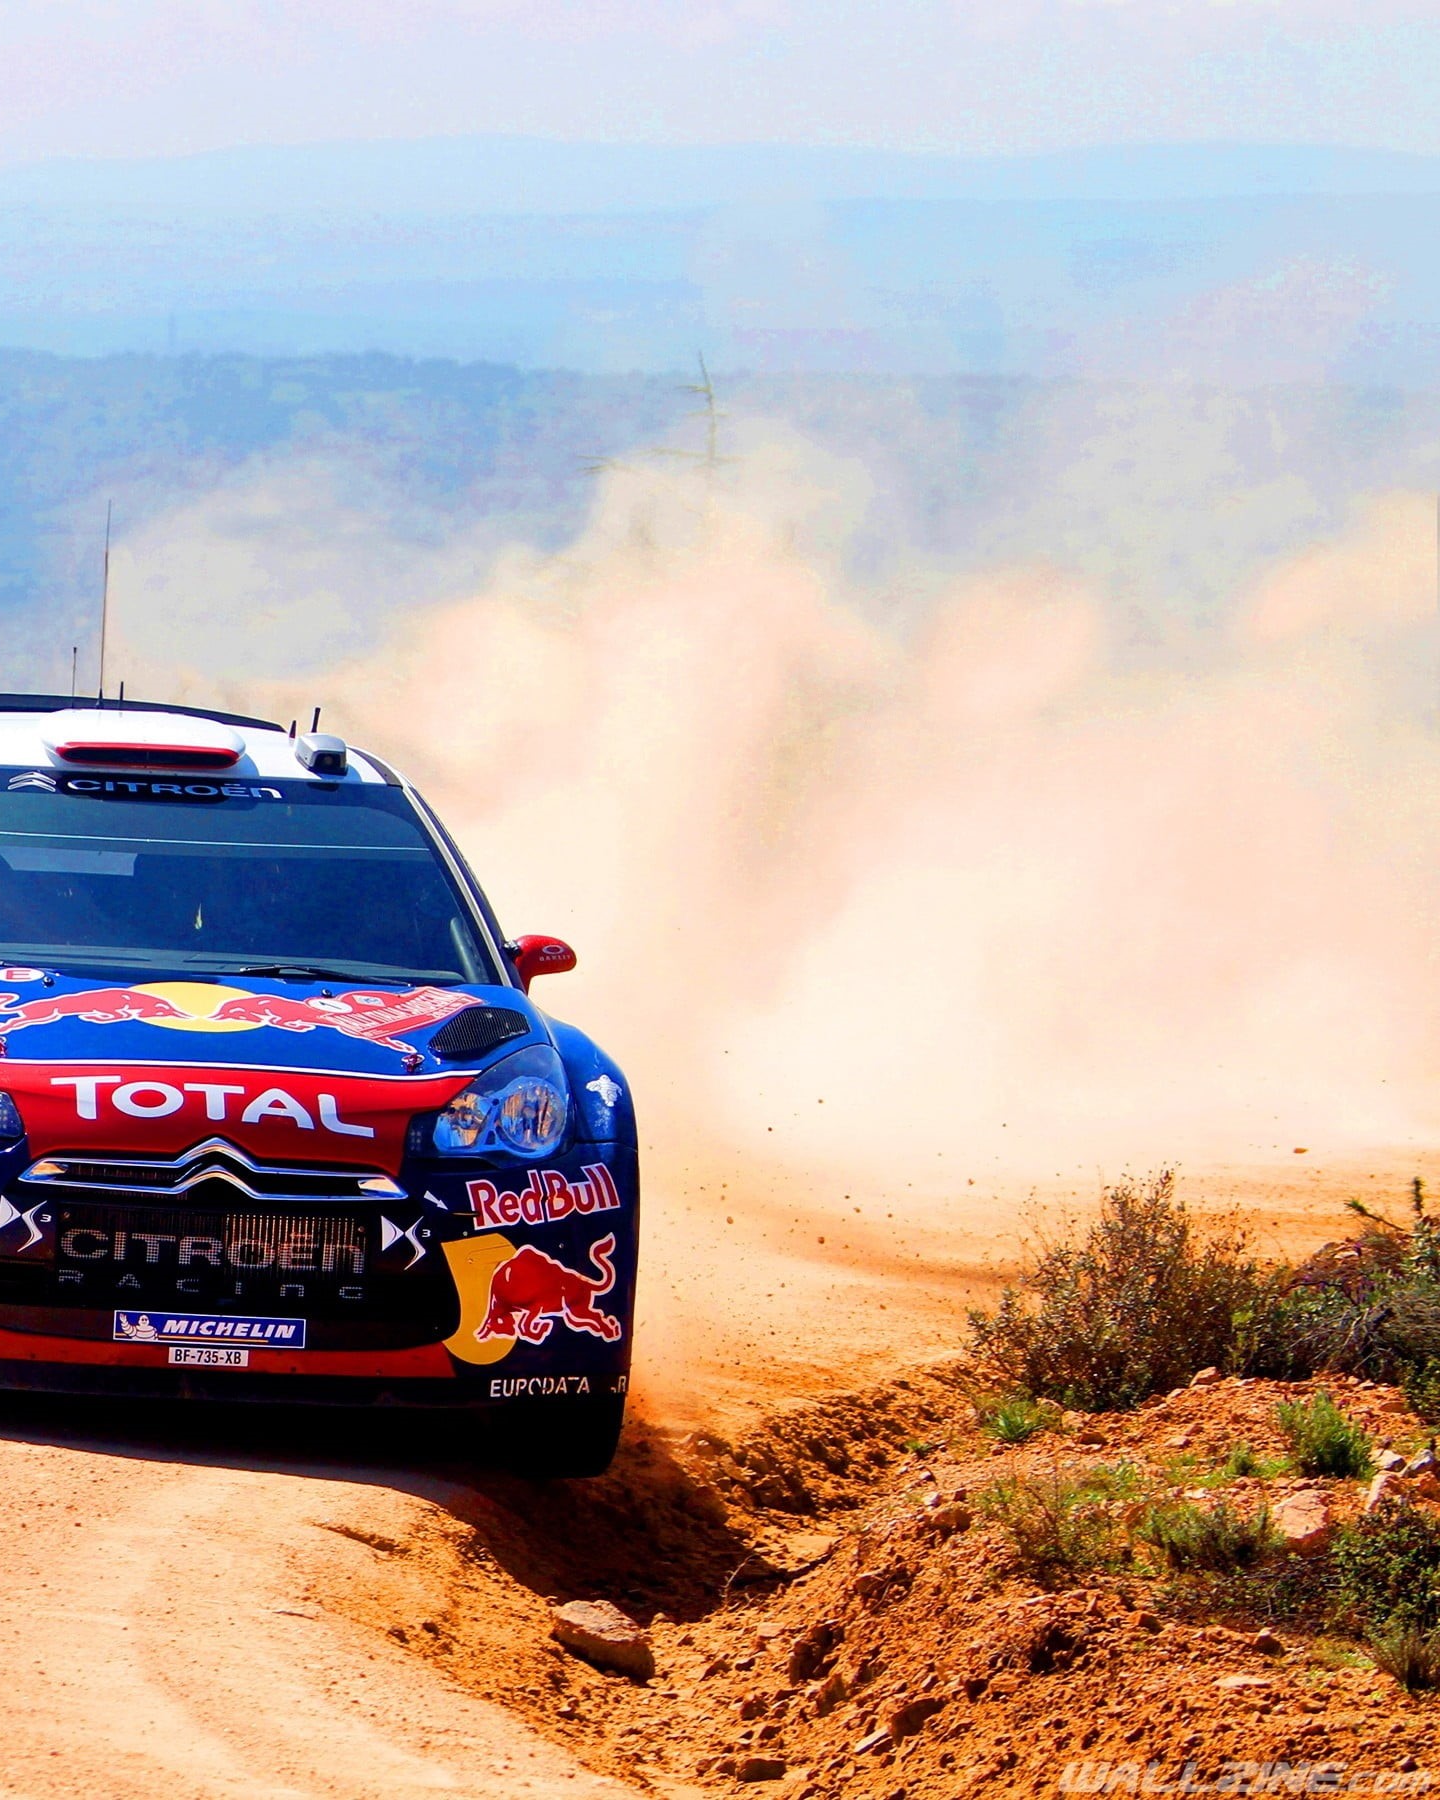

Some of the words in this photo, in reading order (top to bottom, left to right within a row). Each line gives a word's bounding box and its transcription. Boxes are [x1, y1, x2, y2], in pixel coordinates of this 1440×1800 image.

[50, 1075, 375, 1138] TOTAL
[162, 1319, 297, 1340] MICHELIN
[173, 1349, 243, 1366] BF-735-XB
